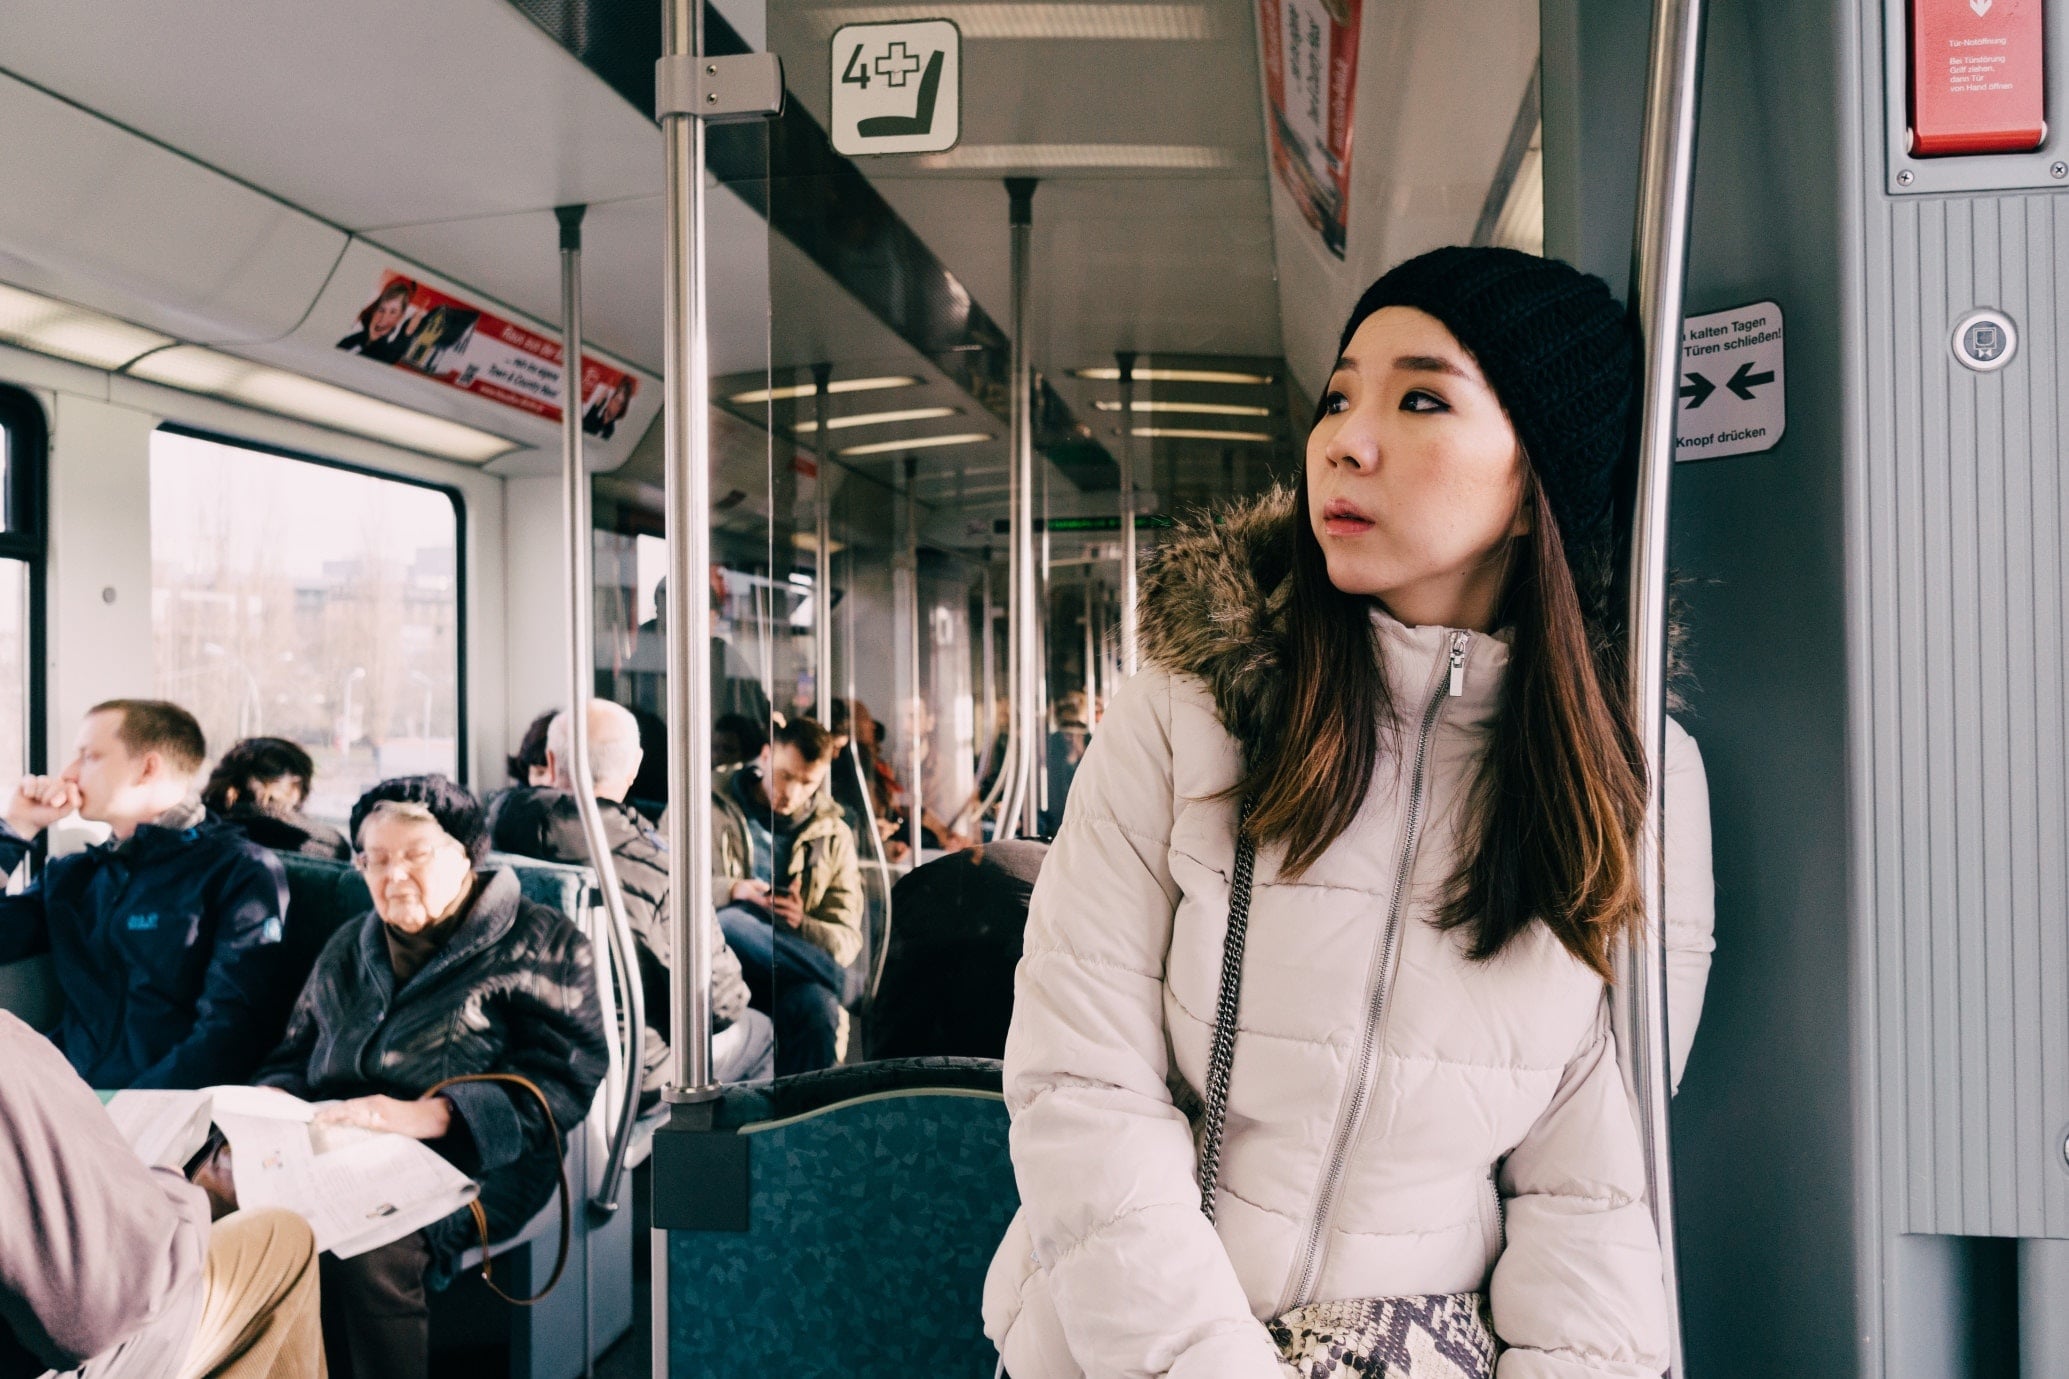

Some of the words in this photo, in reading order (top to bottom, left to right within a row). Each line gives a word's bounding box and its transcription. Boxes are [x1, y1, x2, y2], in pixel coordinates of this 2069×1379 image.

[1949, 38, 2006, 46] Tür-Notöffnung
[842, 43, 871, 89] 4
[1690, 324, 1728, 341] kalten
[1731, 317, 1766, 333] Tagen
[1684, 342, 1720, 357] Türen
[1724, 328, 1782, 351] schließen!
[1676, 434, 1714, 449] Knopf
[1718, 427, 1766, 444] drücken
